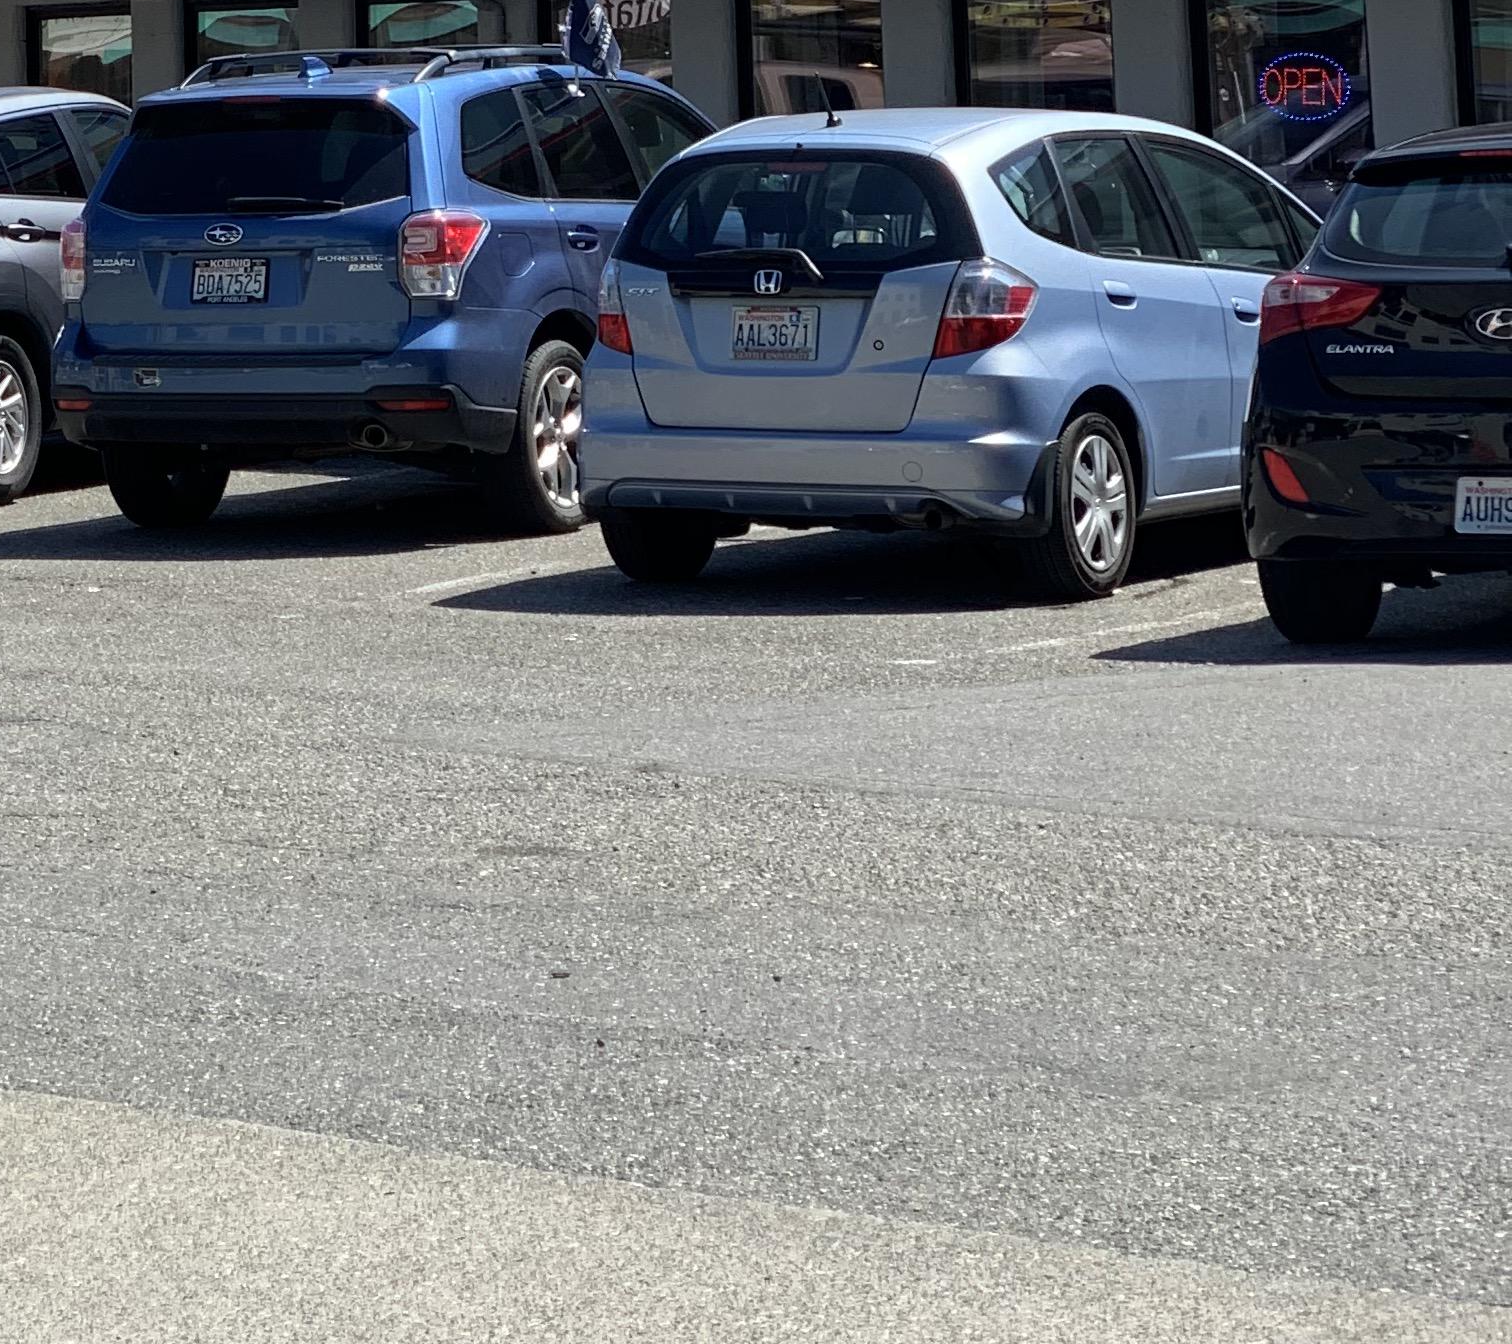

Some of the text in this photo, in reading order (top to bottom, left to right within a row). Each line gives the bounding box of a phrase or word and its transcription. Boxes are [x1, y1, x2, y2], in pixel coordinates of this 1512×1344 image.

[1263, 68, 1342, 105] OPEN
[92, 258, 136, 267] SUBARU
[196, 273, 263, 295] BDA7525
[735, 323, 808, 347] AAL3671
[1325, 344, 1395, 354] ELANTRA
